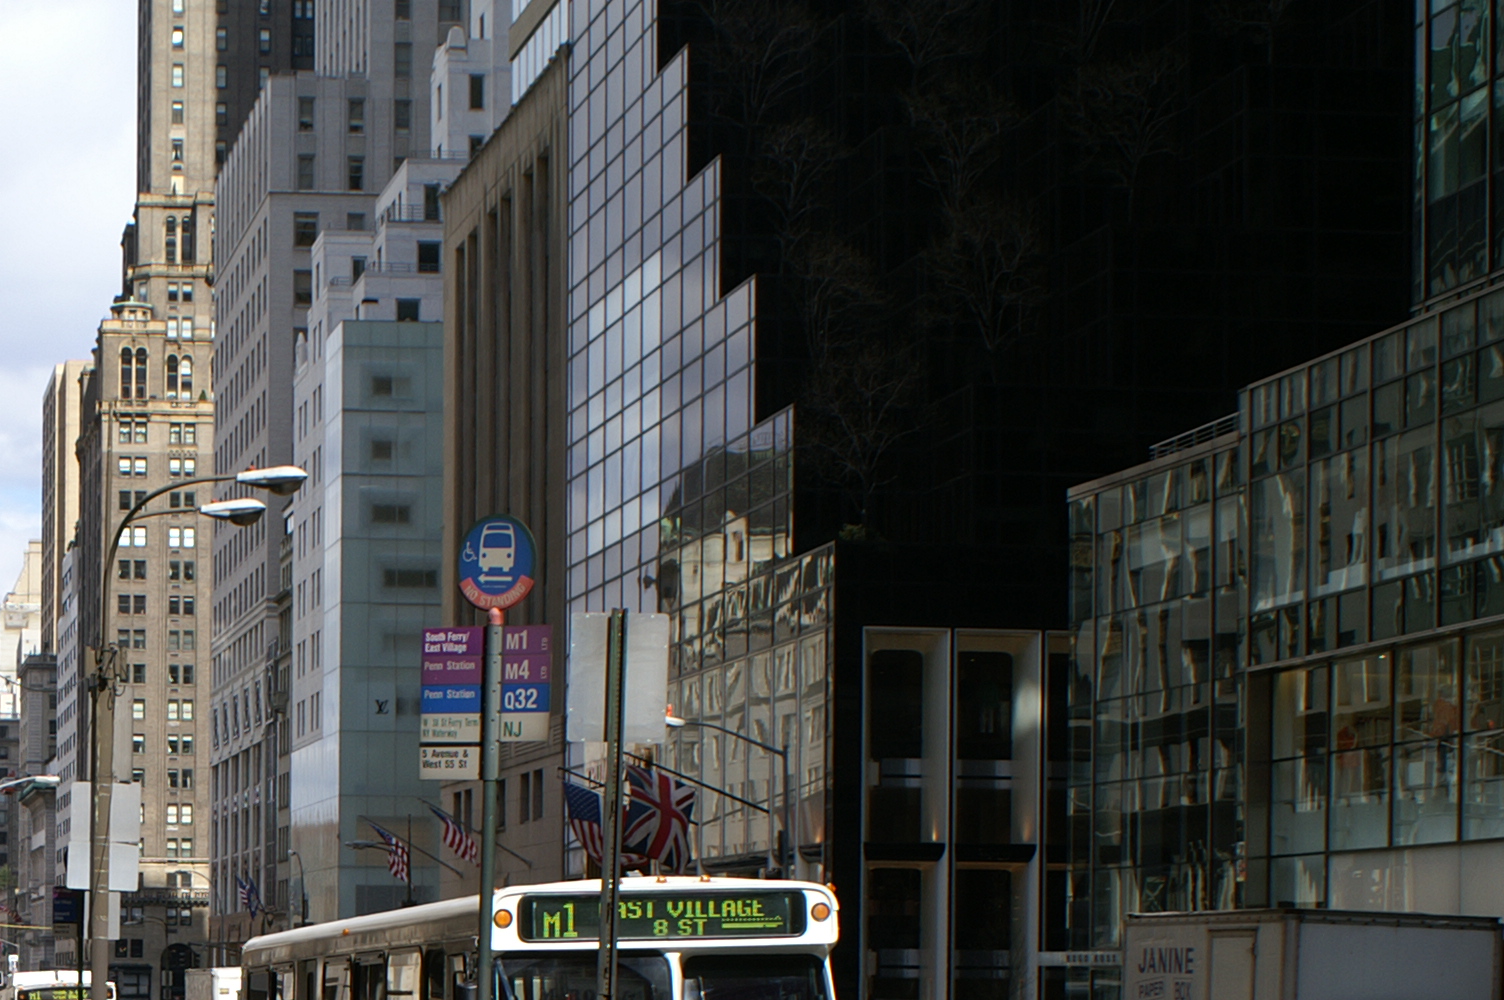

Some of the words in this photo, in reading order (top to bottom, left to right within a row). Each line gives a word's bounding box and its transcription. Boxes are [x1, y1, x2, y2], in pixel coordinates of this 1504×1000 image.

[464, 585, 479, 601] NO
[479, 583, 527, 607] STANDING
[425, 632, 446, 642] South
[506, 629, 528, 650] M1
[424, 643, 441, 653] East
[442, 642, 467, 654] Village
[424, 661, 444, 671] Penn
[446, 660, 476, 671] Station
[505, 659, 530, 680] M4
[424, 689, 444, 699] Penn
[446, 689, 476, 699] Station
[504, 688, 538, 710] Q32
[503, 722, 523, 738] NJ
[431, 749, 459, 758] Avenue
[462, 749, 469, 758] &
[422, 760, 442, 769] West
[458, 760, 468, 769] St
[599, 901, 654, 919] AST
[666, 900, 766, 918] VILLAGE
[542, 903, 578, 938] M1
[653, 919, 668, 936] 8
[677, 919, 707, 936] ST
[1138, 947, 1194, 974] JANINE
